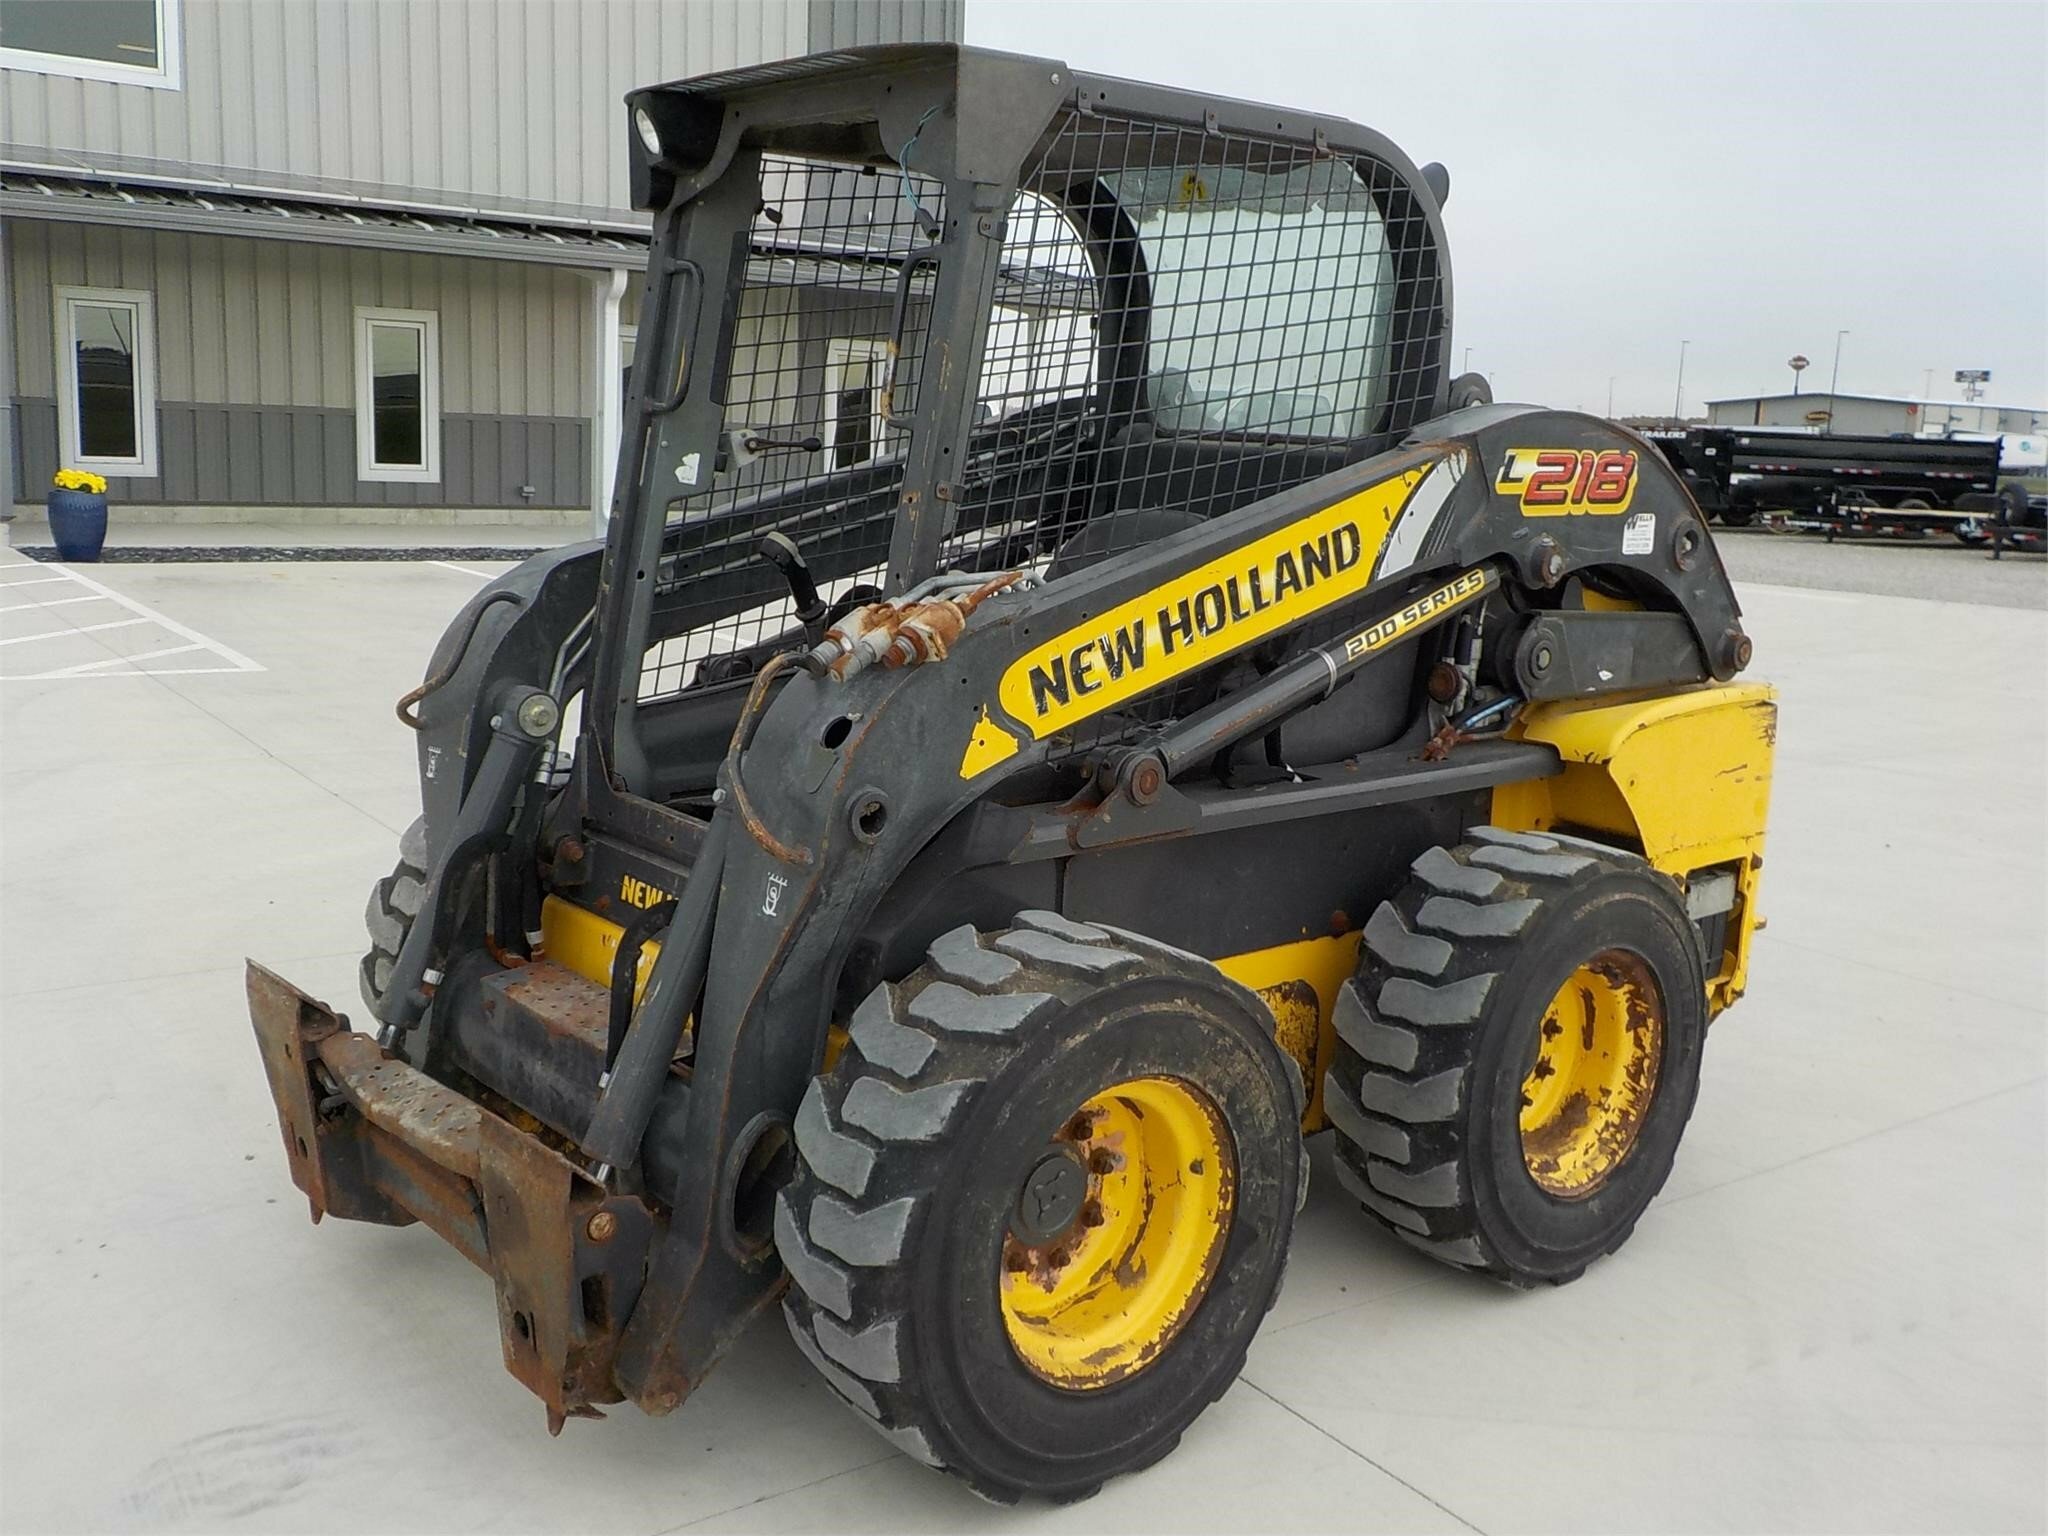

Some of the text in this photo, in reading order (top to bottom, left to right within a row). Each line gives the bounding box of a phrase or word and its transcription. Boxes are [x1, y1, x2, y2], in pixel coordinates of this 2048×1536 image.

[1028, 522, 1361, 717] NEW HOLLAND
[1347, 570, 1482, 658] 200 SERIES
[621, 874, 663, 910] NEW
